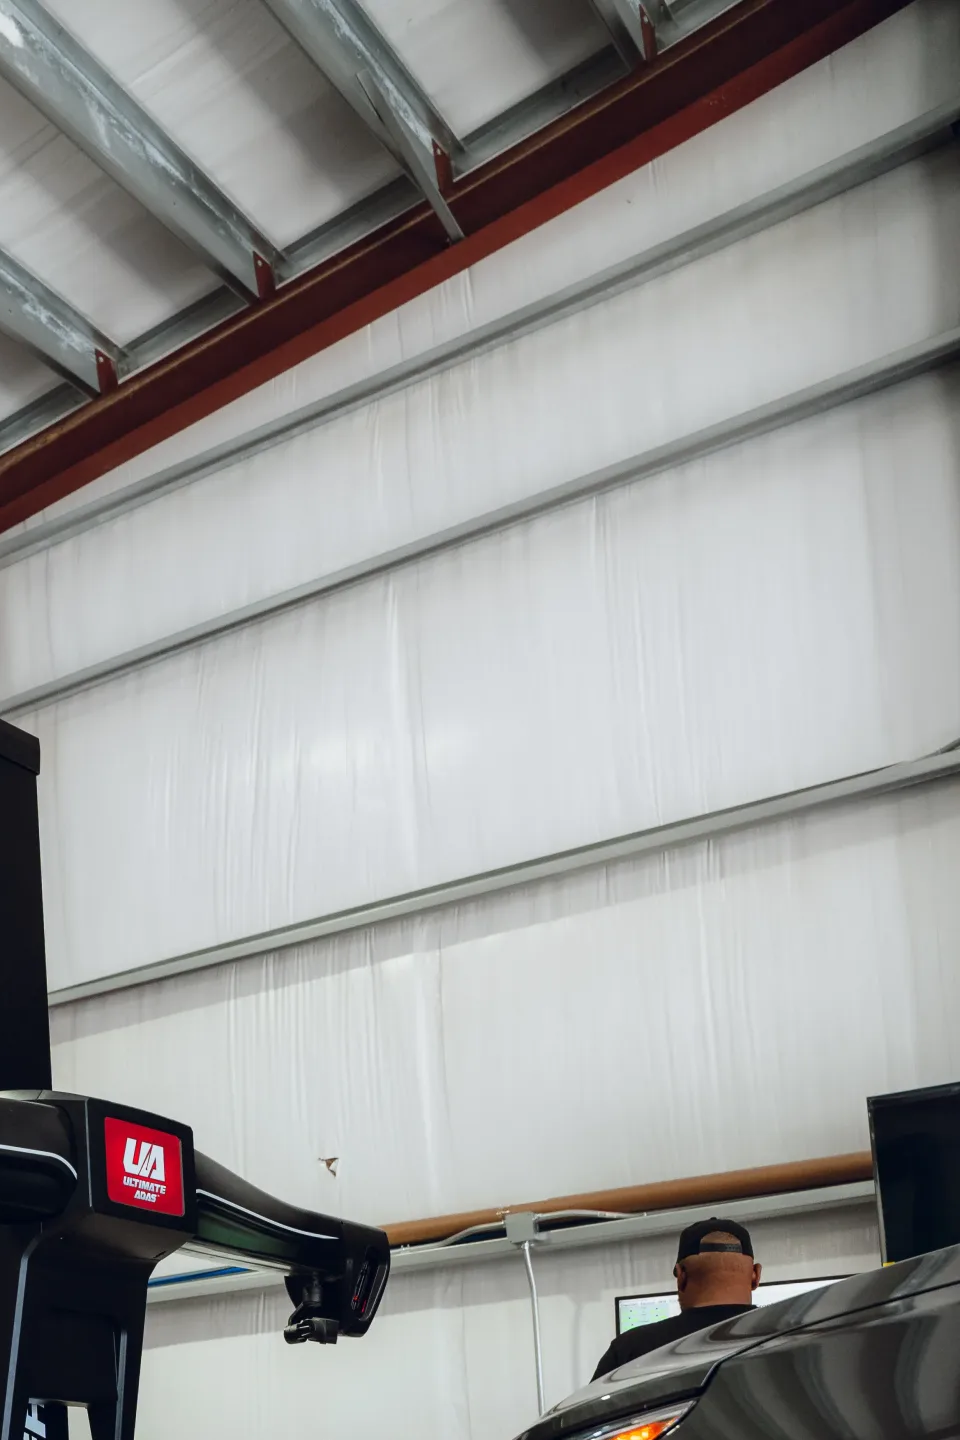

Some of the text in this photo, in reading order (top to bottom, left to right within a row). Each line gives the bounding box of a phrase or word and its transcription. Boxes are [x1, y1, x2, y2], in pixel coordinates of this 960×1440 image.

[123, 1137, 165, 1182] UA
[123, 1176, 166, 1195] ULTIMATE
[134, 1190, 157, 1203] ADAS
